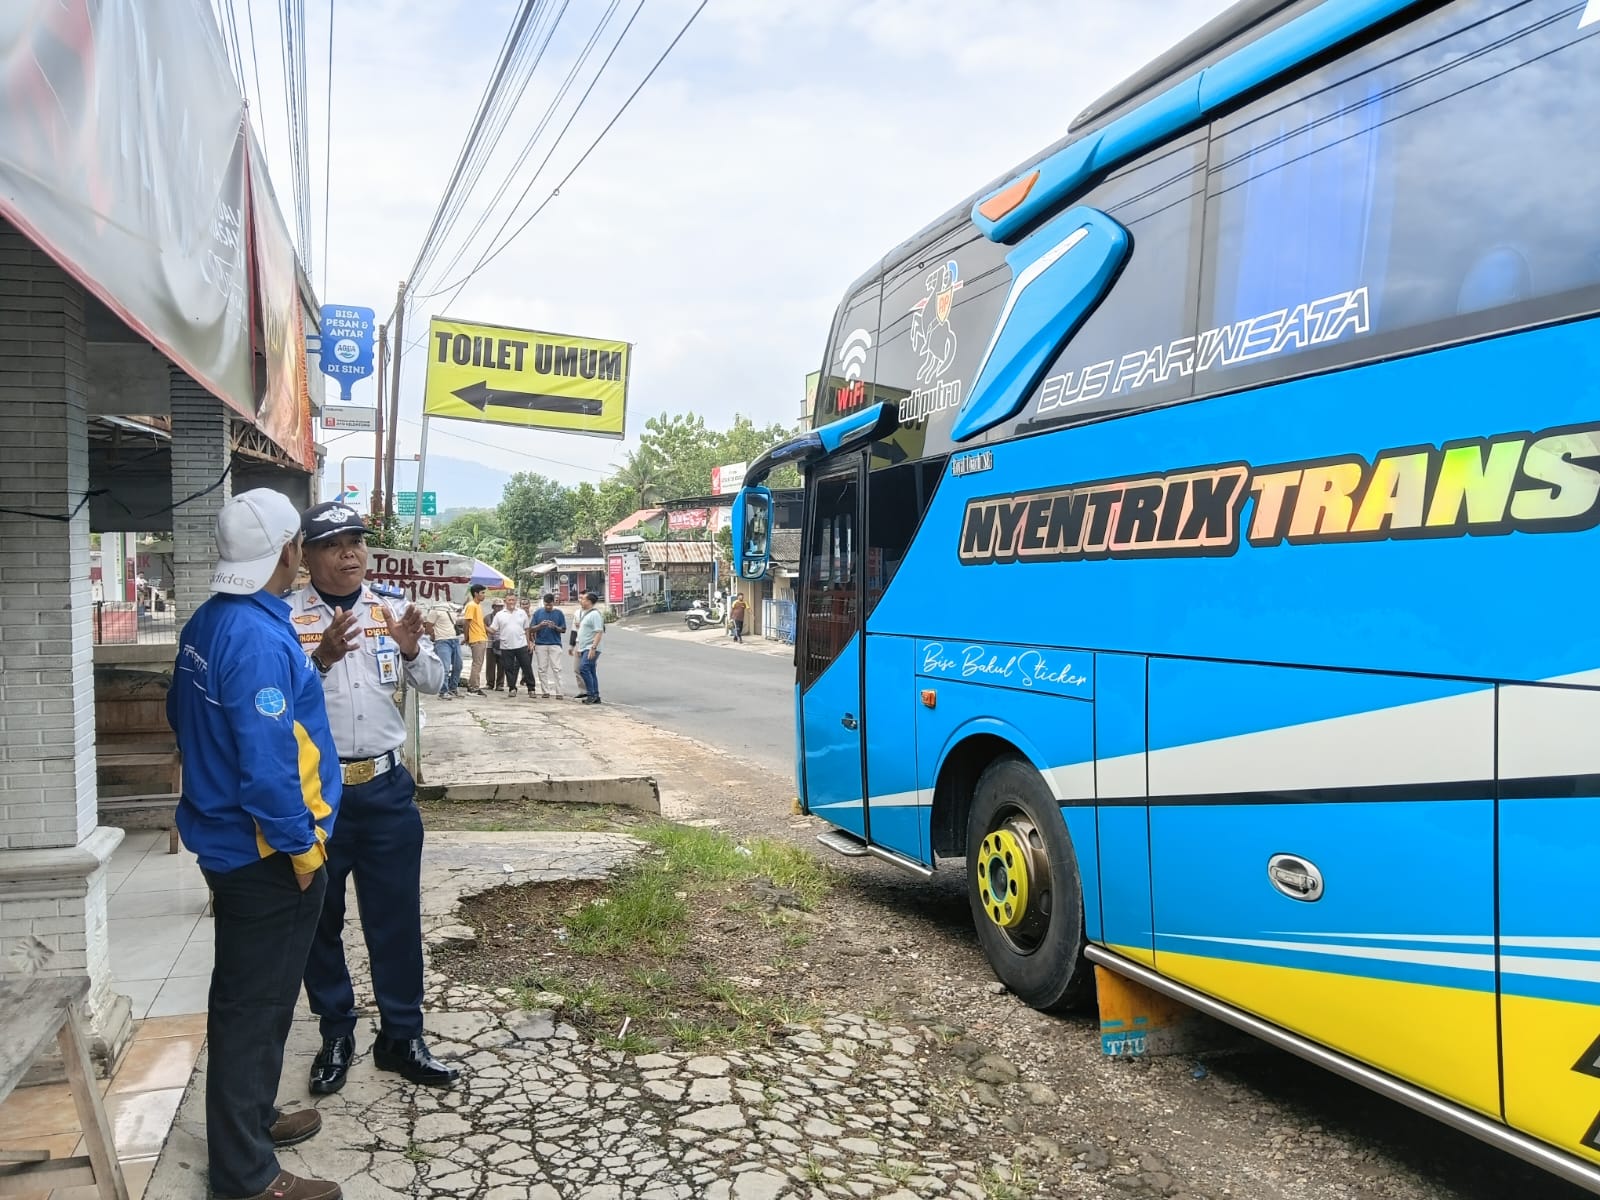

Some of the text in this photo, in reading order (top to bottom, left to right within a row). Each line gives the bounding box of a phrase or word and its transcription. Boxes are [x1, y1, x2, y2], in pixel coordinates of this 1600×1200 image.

[326, 318, 368, 329] PESAN &
[335, 309, 360, 319] BISA
[329, 328, 364, 338] ANTAR
[435, 331, 622, 382] TOILET UMUM
[1038, 287, 1370, 413] BUS PARIWISATA
[327, 364, 365, 374] DI SINI
[837, 379, 865, 412] WiFi
[898, 379, 962, 423] adiputro
[961, 427, 1600, 560] NYENTRIX TRANS
[372, 552, 450, 577] TOILET
[366, 628, 390, 636] DISH
[922, 641, 1088, 688] Bise Bakul Sticker
